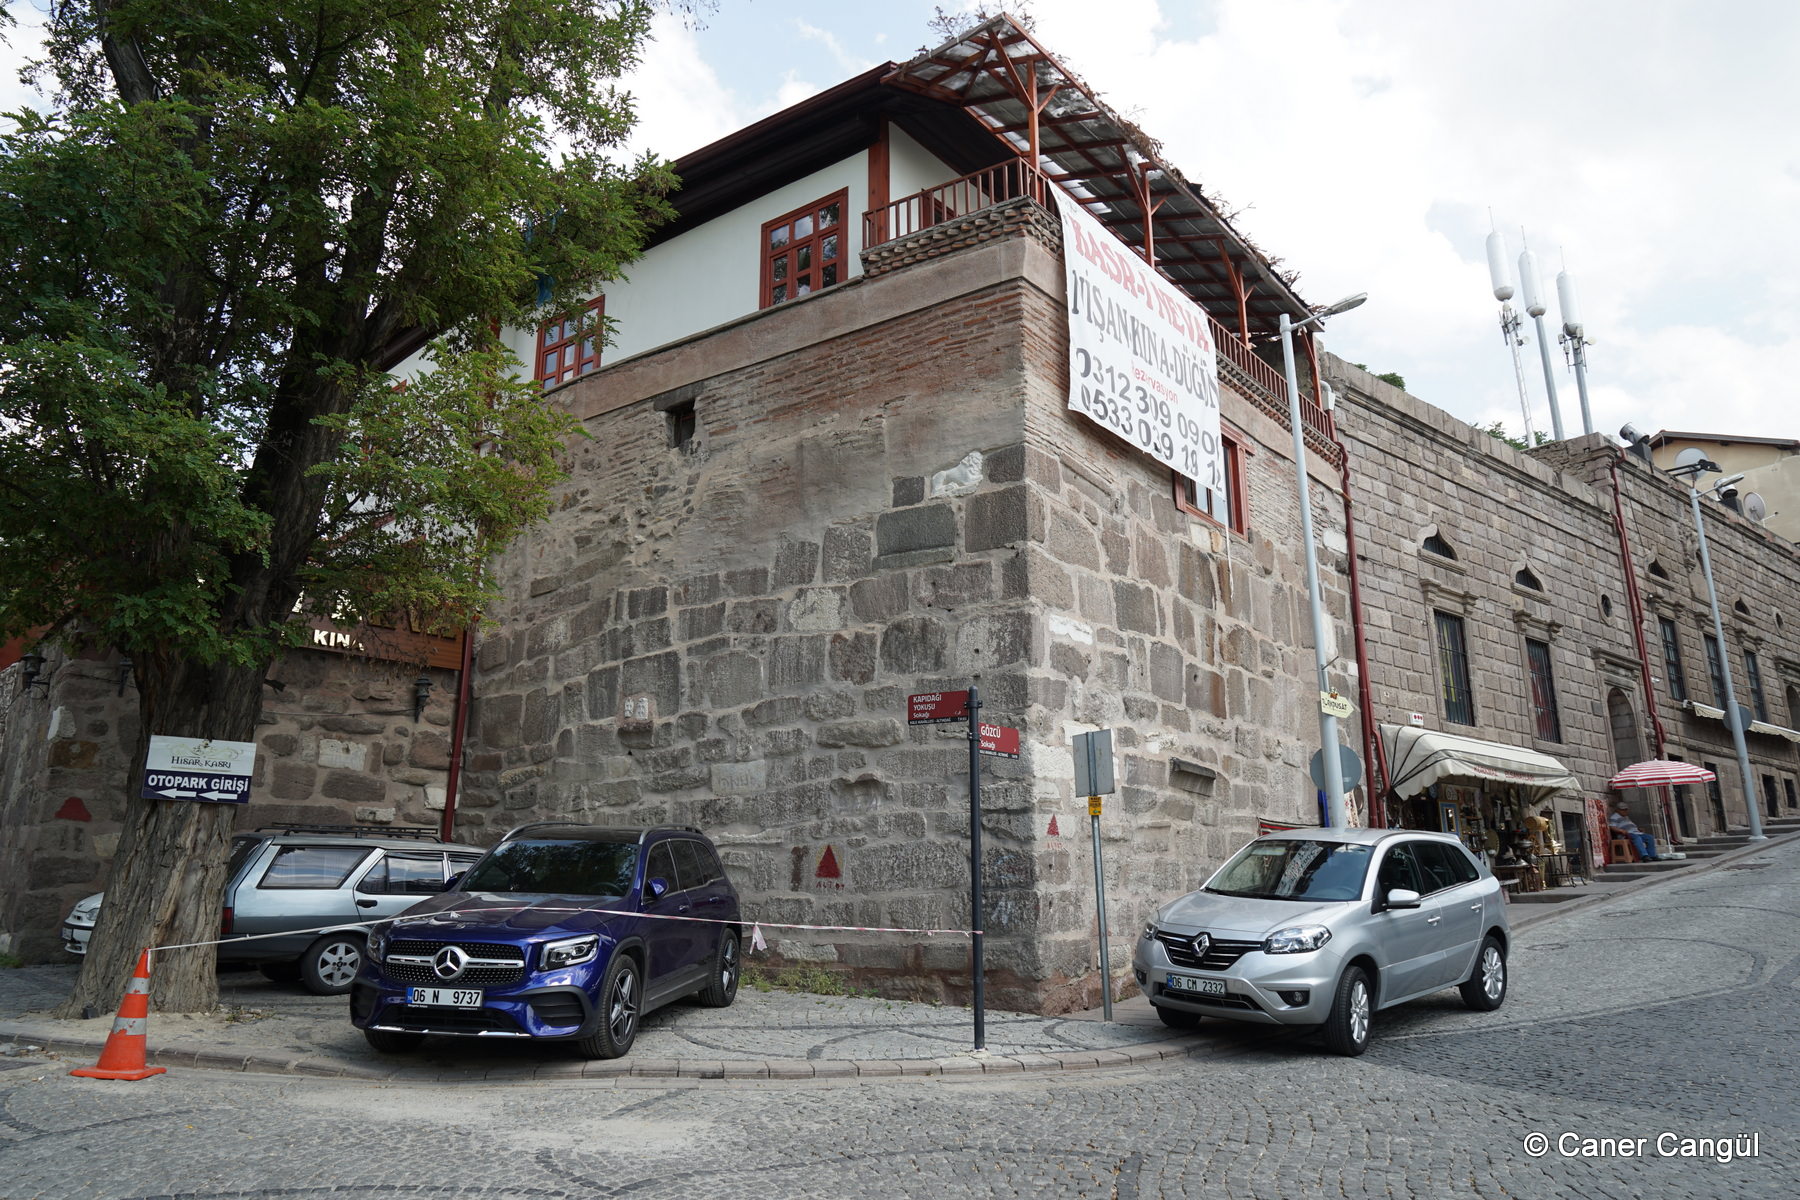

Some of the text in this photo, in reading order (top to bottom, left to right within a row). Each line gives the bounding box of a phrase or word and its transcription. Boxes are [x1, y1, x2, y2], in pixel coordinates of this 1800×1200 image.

[1151, 281, 1210, 353] NEVA
[1076, 348, 1220, 462] 0312 309 09 0
[1081, 384, 1133, 435] 0533
[913, 694, 942, 703] KAPIDAĞI
[913, 703, 936, 711] YOKUŞU
[980, 724, 1001, 739] GÖZCÜ
[980, 740, 996, 751] Sokağı
[148, 774, 249, 794] OTOPARK GİRİŞİ
[1172, 976, 1223, 994] 06 CM 2332
[413, 989, 481, 1005] 06 N 9737
